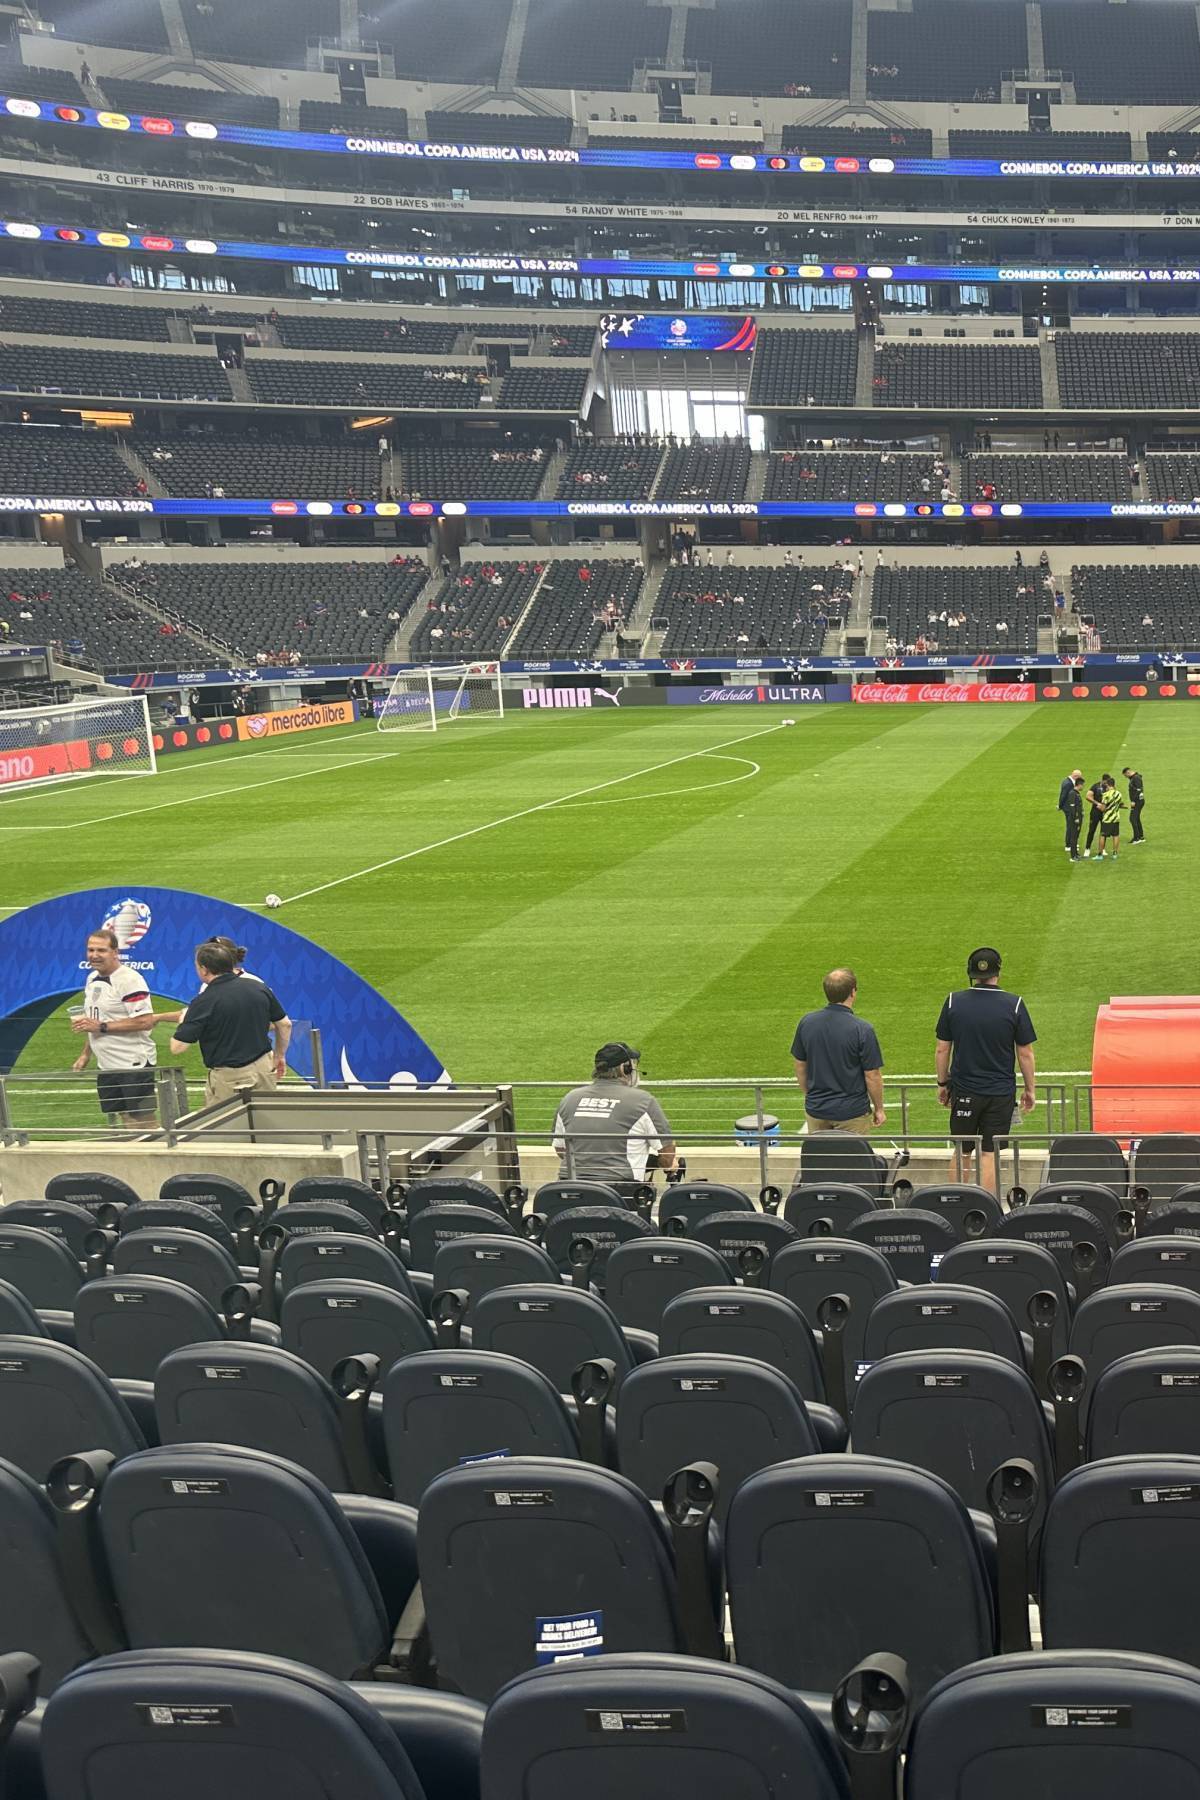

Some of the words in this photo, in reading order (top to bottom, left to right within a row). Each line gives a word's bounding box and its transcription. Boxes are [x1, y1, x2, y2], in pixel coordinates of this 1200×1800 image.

[347, 139, 423, 156] CONMEBOL
[424, 145, 459, 157] COPA
[459, 147, 519, 160] AMERICA
[521, 149, 547, 160] USA
[549, 150, 579, 162] 2024
[1001, 162, 1065, 175] CONMEBOL
[1067, 163, 1098, 175] COPA
[1099, 163, 1150, 175] AMERICA
[1152, 163, 1174, 175] USA
[96, 173, 110, 183] 43
[116, 175, 148, 187] CLIFF
[152, 177, 195, 191] HARRIS
[353, 196, 366, 204] 22
[370, 197, 391, 207] BOB
[394, 199, 428, 210] HAYES
[565, 206, 578, 214] 54
[581, 207, 613, 216] RANDY
[615, 207, 648, 216] WHITE
[777, 213, 790, 221] 20
[793, 213, 810, 221] MEL
[812, 213, 847, 221] RENFRO
[967, 216, 979, 224] 54
[981, 216, 1010, 224] CHUCK
[1011, 216, 1045, 224] HOWLEY
[1162, 216, 1171, 224] 17
[1175, 216, 1193, 224] DON
[346, 252, 422, 266] CONMEBOL
[424, 256, 460, 268] COPA
[460, 258, 518, 270] AMERICA
[521, 259, 546, 270] USA
[548, 261, 578, 271] 2024
[998, 269, 1063, 280] CONMEBOL
[1064, 269, 1095, 280] COPA
[1095, 269, 1147, 280] AMERICA
[1149, 270, 1171, 280] USA
[1173, 270, 1200, 280] 2024
[0, 498, 35, 511] COPA
[35, 499, 95, 512] AMERICA
[96, 500, 121, 512] USA
[123, 501, 154, 513] 2024
[568, 503, 629, 514] CONMEBOL
[630, 503, 659, 514] COPA
[660, 503, 708, 514] AMERICA
[711, 503, 731, 514] USA
[732, 503, 758, 514] 2024
[1111, 504, 1165, 515] CONMEBOL
[1167, 504, 1193, 515] COPA
[523, 687, 592, 708] PUMA
[699, 688, 754, 703] Michelob
[768, 688, 823, 701] ULTRA
[272, 710, 320, 732] mercado
[322, 705, 345, 725] libre
[578, 1098, 621, 1109] BEST
